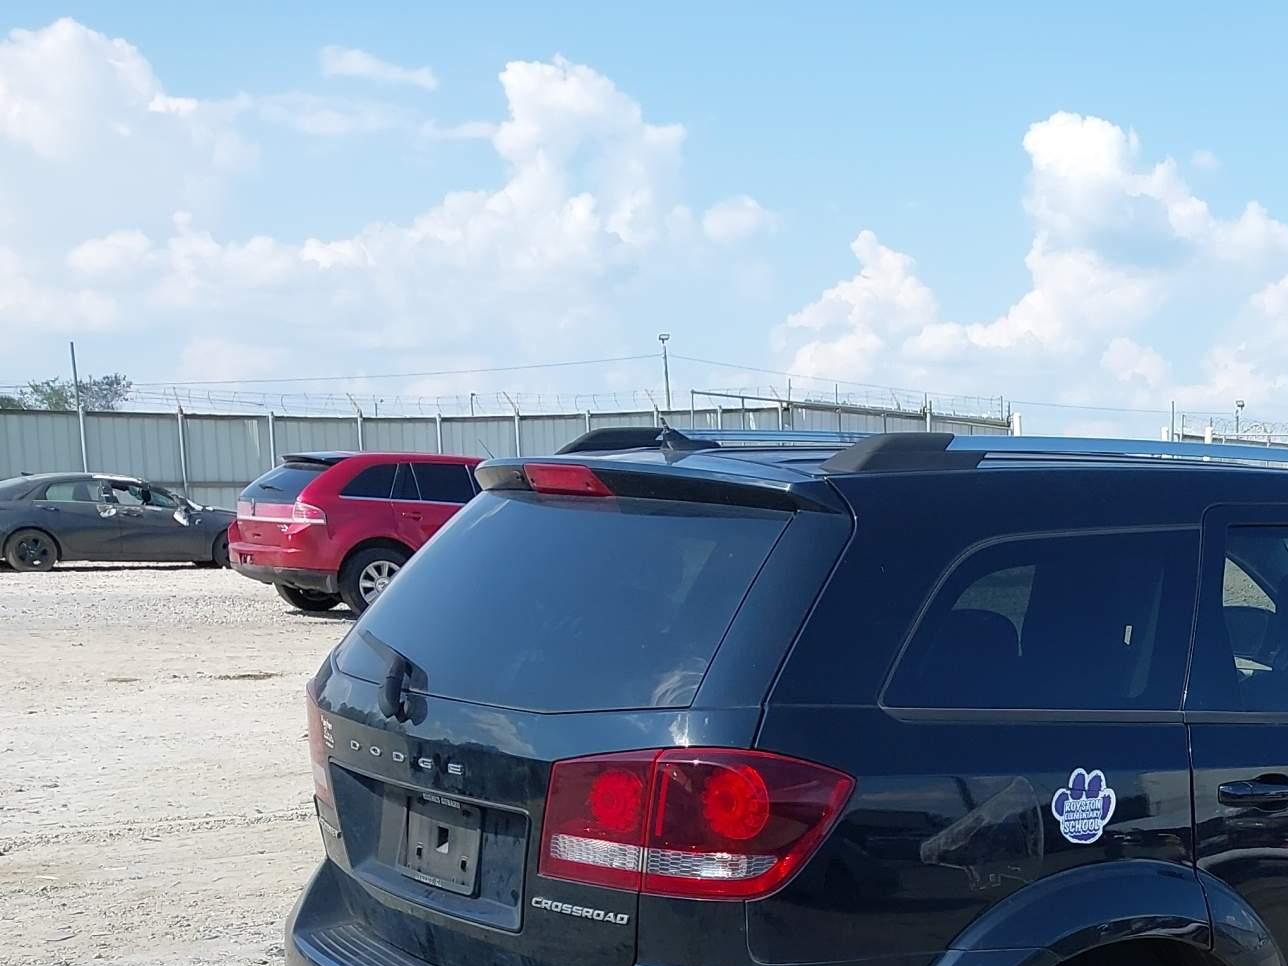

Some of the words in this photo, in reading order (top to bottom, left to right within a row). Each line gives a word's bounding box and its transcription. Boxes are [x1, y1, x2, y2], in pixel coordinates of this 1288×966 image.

[350, 740, 463, 775] DODGE
[1065, 799, 1101, 812] ROYSTON
[1065, 811, 1101, 820] ELEMENTARY
[1063, 819, 1100, 833] SCHOOL
[531, 897, 629, 925] CROSSROAD
